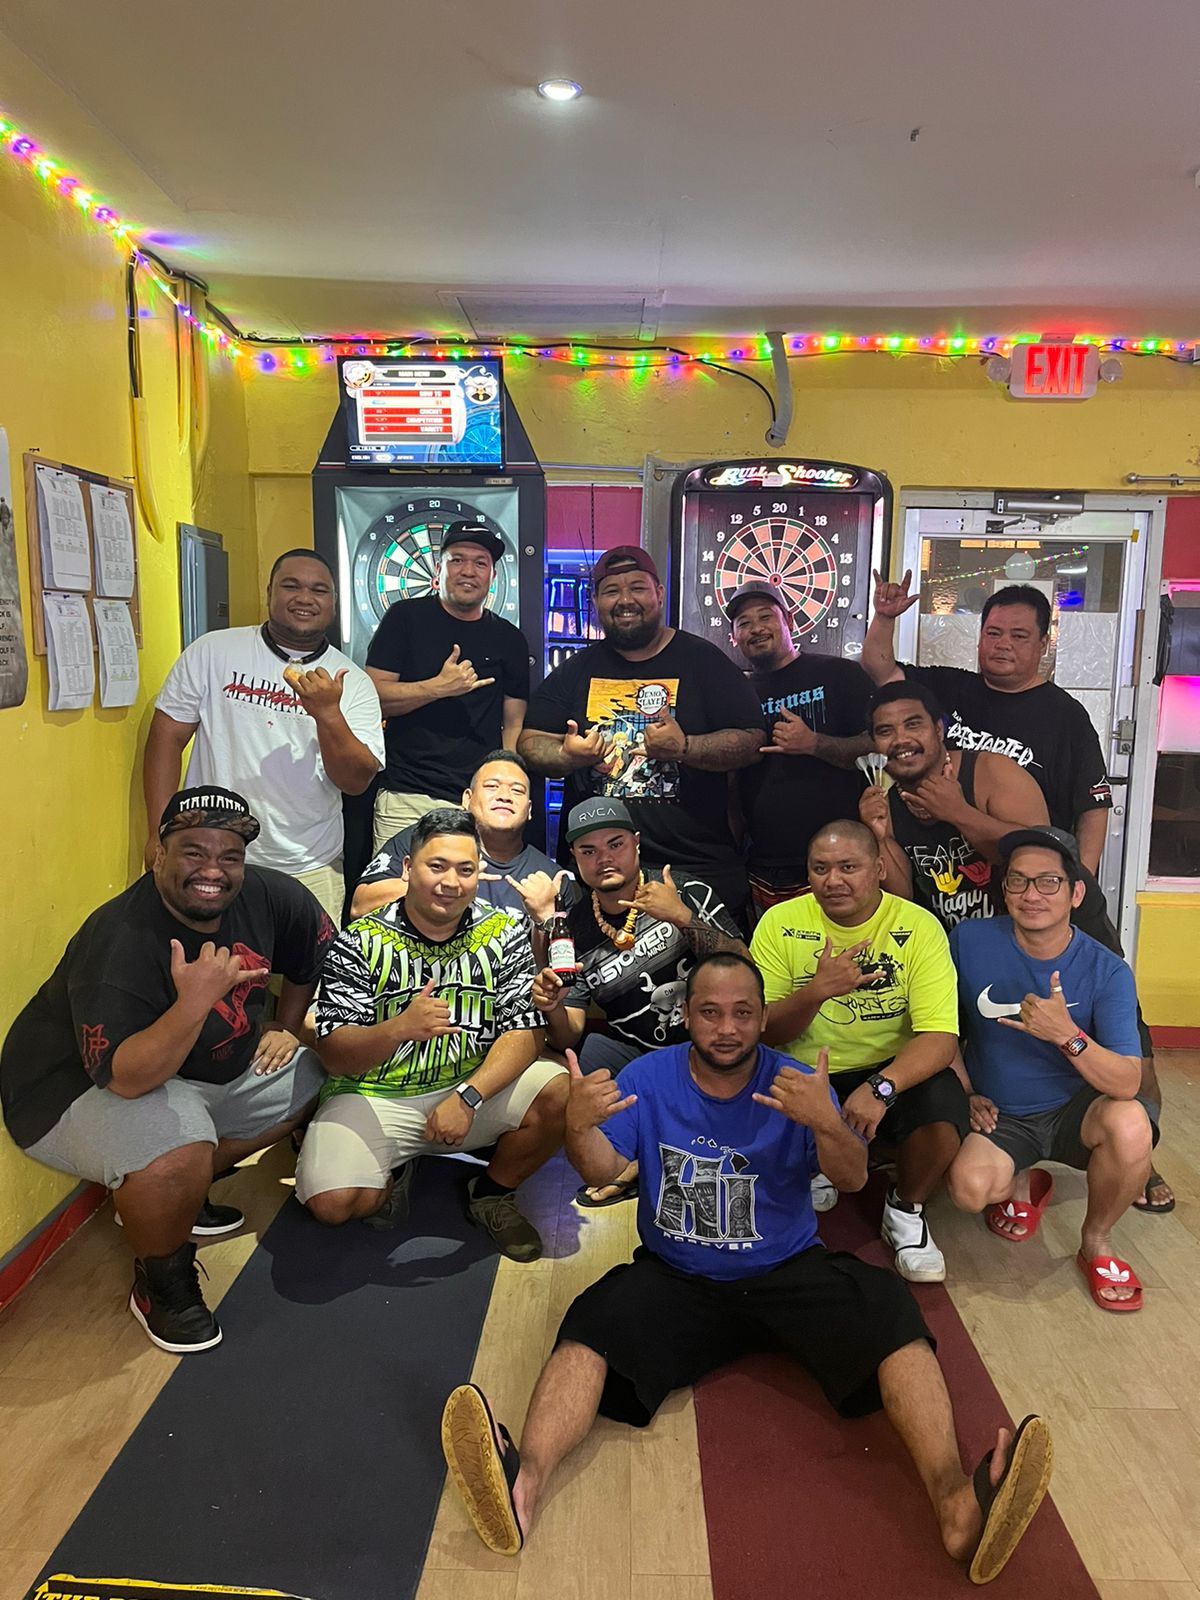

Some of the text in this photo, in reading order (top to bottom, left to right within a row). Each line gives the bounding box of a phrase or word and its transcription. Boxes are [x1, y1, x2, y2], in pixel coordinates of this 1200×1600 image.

[1024, 346, 1089, 394] EXIT
[429, 500, 440, 508] 20
[457, 503, 462, 511] 1
[772, 503, 787, 513] 20
[753, 505, 761, 515] 5
[799, 507, 804, 516] 1
[385, 515, 395, 523] 12
[476, 515, 485, 523] 18
[730, 514, 743, 524] 12
[815, 516, 827, 526] 18
[716, 532, 725, 542] 9
[831, 534, 839, 544] 4
[702, 551, 714, 561] 14
[840, 553, 853, 564] 13
[700, 574, 711, 584] 11
[842, 575, 850, 585] 6
[704, 597, 712, 606] 8
[837, 597, 849, 607] 10
[710, 617, 722, 626] 16
[827, 618, 838, 628] 15
[811, 634, 818, 643] 2
[761, 686, 824, 715] rianas
[579, 808, 617, 823] RVCA
